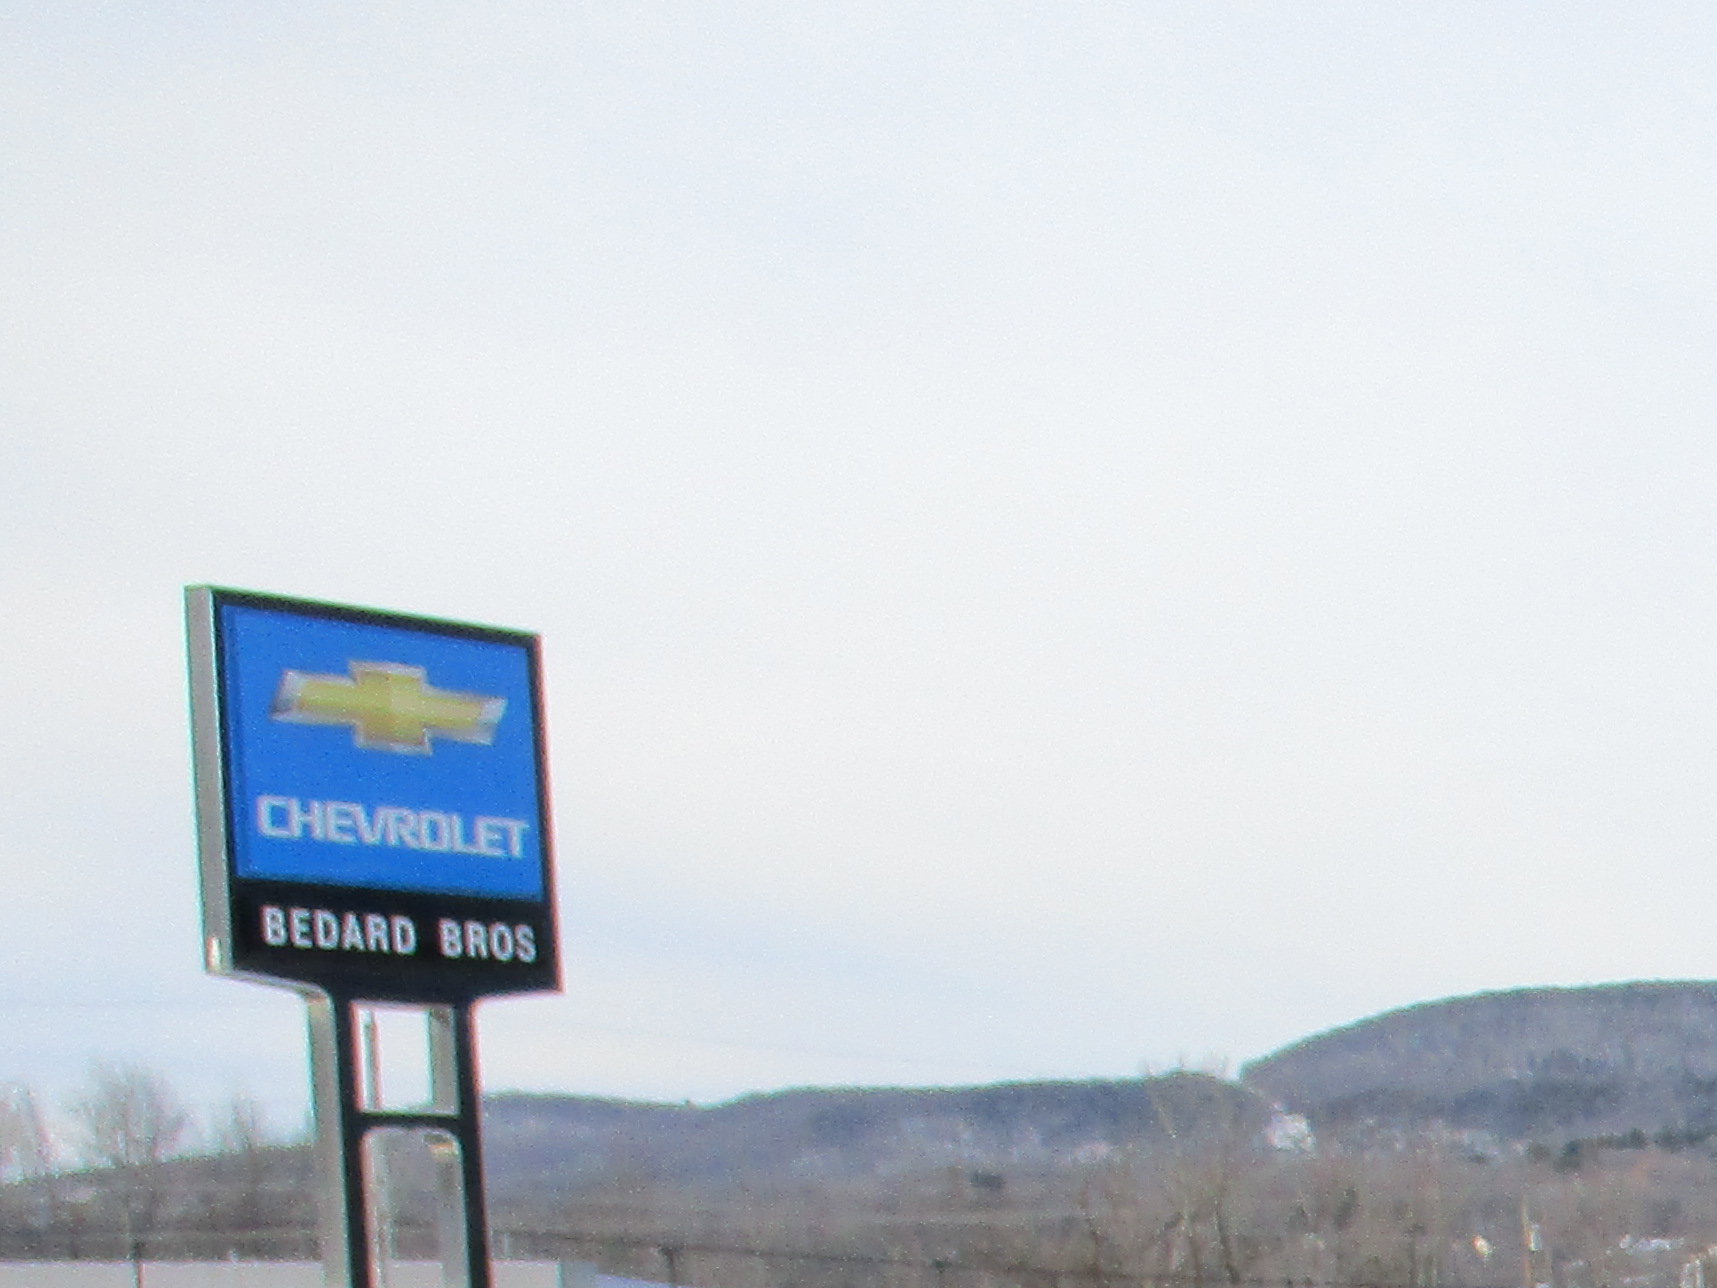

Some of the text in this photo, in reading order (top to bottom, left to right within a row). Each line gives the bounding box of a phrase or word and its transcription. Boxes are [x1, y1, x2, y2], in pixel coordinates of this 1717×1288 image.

[257, 795, 529, 858] CHEVROLET
[261, 905, 538, 964] BEDARD BROS
